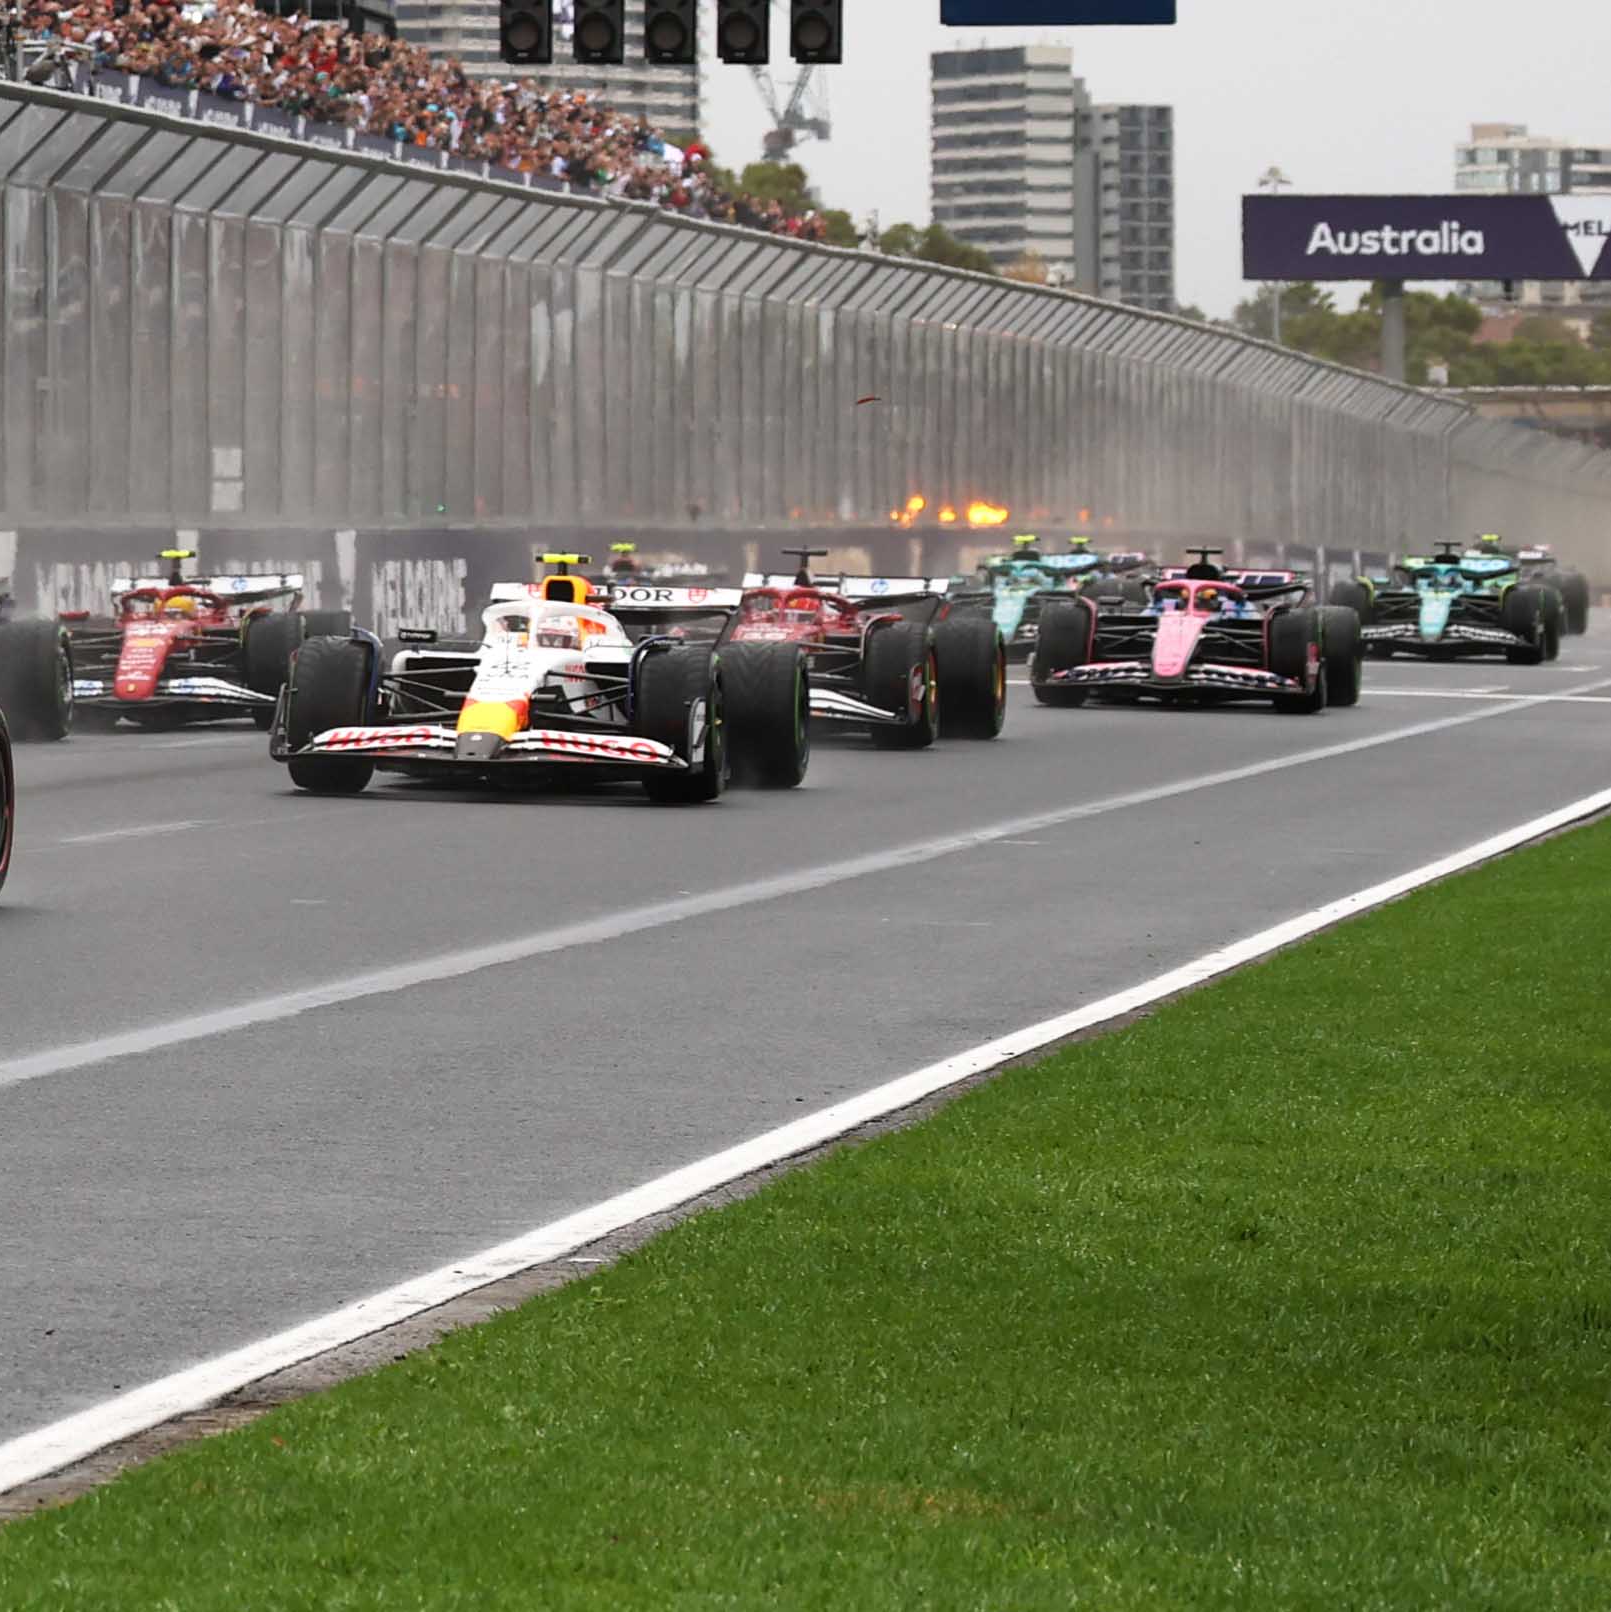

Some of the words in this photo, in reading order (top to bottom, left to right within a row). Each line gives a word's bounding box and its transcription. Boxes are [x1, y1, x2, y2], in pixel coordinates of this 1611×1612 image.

[1306, 220, 1484, 256] Australia
[612, 588, 675, 602] DOR
[327, 727, 433, 750] HUGO
[539, 731, 659, 762] HUGO
